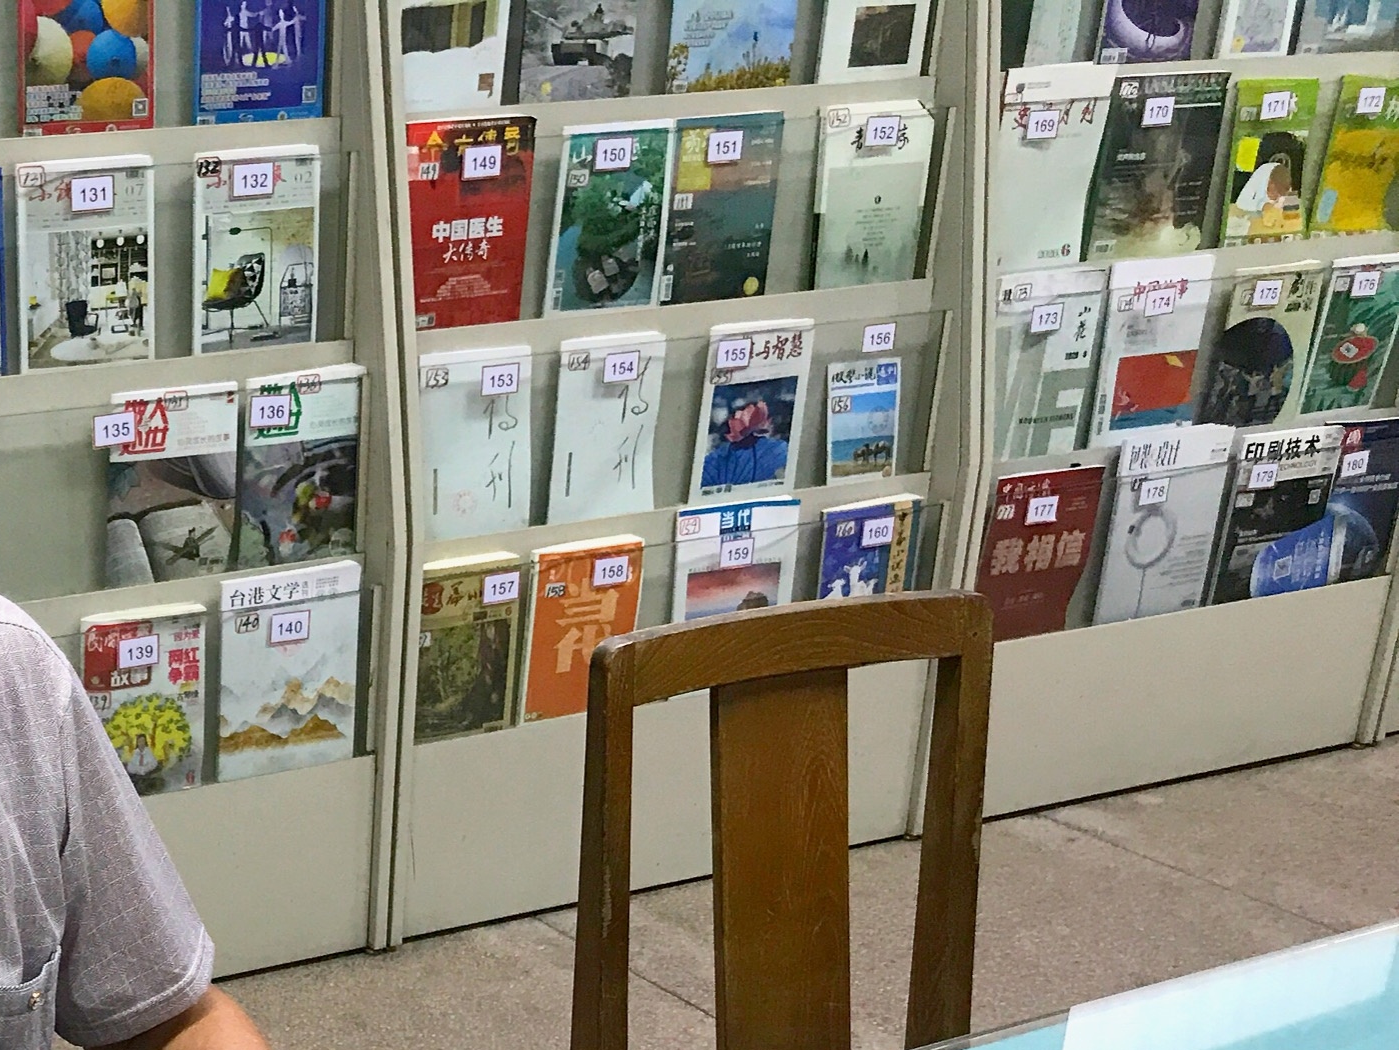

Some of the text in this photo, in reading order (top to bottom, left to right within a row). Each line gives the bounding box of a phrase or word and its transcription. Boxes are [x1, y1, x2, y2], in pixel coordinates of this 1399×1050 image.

[1267, 100, 1285, 112] 171
[1363, 95, 1381, 107] 172
[1149, 105, 1169, 118] 170
[1035, 119, 1055, 132] 169
[873, 126, 894, 140] 152
[603, 148, 625, 162] 150
[716, 142, 737, 155] 151
[472, 156, 496, 171] 149
[242, 174, 267, 188] 132
[80, 187, 106, 202] 131
[432, 216, 503, 242] 中国医生
[1358, 279, 1375, 290] 176
[1259, 288, 1278, 300] 175
[1153, 296, 1171, 310] 174
[1039, 312, 1058, 326] 173
[871, 332, 891, 345] 156
[725, 348, 746, 361] 155
[612, 362, 633, 375] 154
[490, 374, 513, 387] 153
[259, 405, 284, 419] 136
[103, 422, 130, 438] 135
[1244, 434, 1321, 464] 印刷技术
[1347, 458, 1364, 472] 180
[1255, 470, 1274, 483] 179
[1146, 486, 1165, 499] 178
[1034, 504, 1054, 517] 177
[721, 508, 751, 529] 当代
[867, 526, 889, 540] 160
[728, 547, 749, 561] 159
[990, 529, 1086, 576] 我相信
[602, 565, 623, 579] 158
[230, 581, 301, 607] 台港文学
[491, 581, 514, 595] 157
[278, 621, 302, 635] 140
[128, 645, 153, 661] 139
